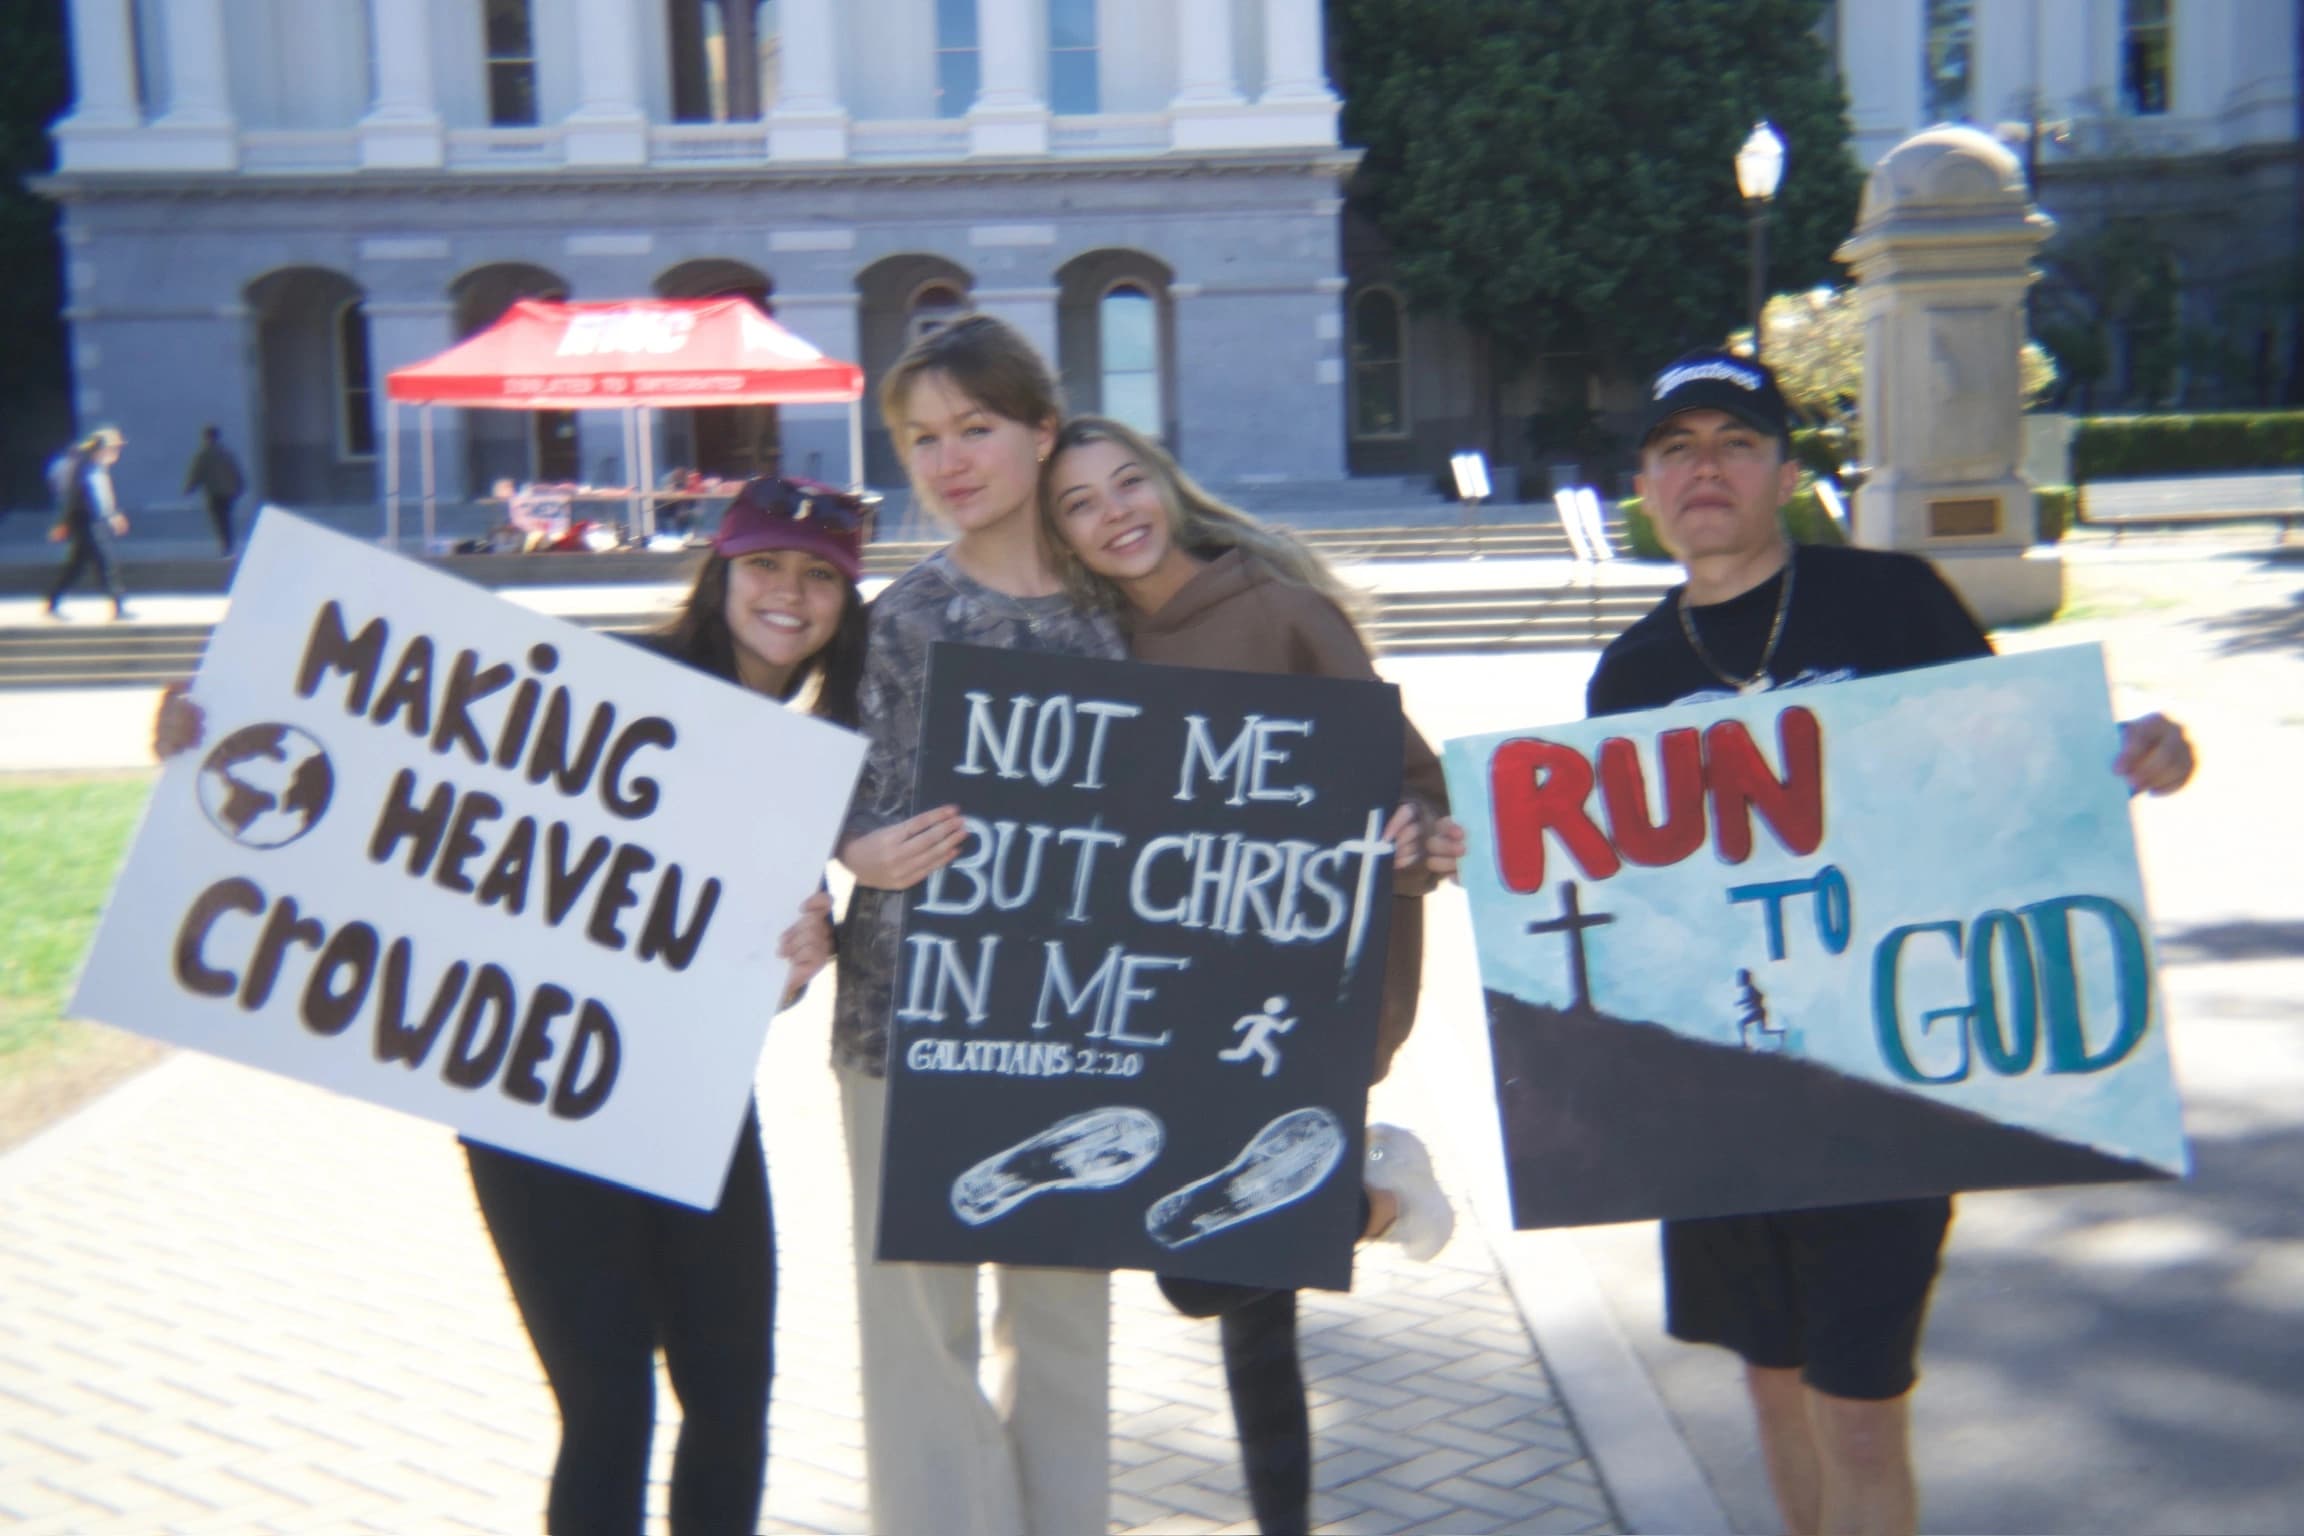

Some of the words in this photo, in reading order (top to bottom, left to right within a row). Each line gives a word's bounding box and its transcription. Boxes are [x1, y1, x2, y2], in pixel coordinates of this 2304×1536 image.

[953, 691, 1143, 789] NOT
[1173, 715, 1316, 806] ME,
[1489, 704, 1827, 894] RUN
[367, 769, 722, 972] HEAVEN
[913, 815, 1126, 922] BUT
[1726, 864, 1853, 961] TO
[897, 934, 1001, 1025] IN
[1031, 940, 1192, 1046] ME
[1872, 894, 2153, 1086] GOD
[906, 1038, 1074, 1077] GALATIANS
[1075, 1048, 1146, 1077] 2:20
